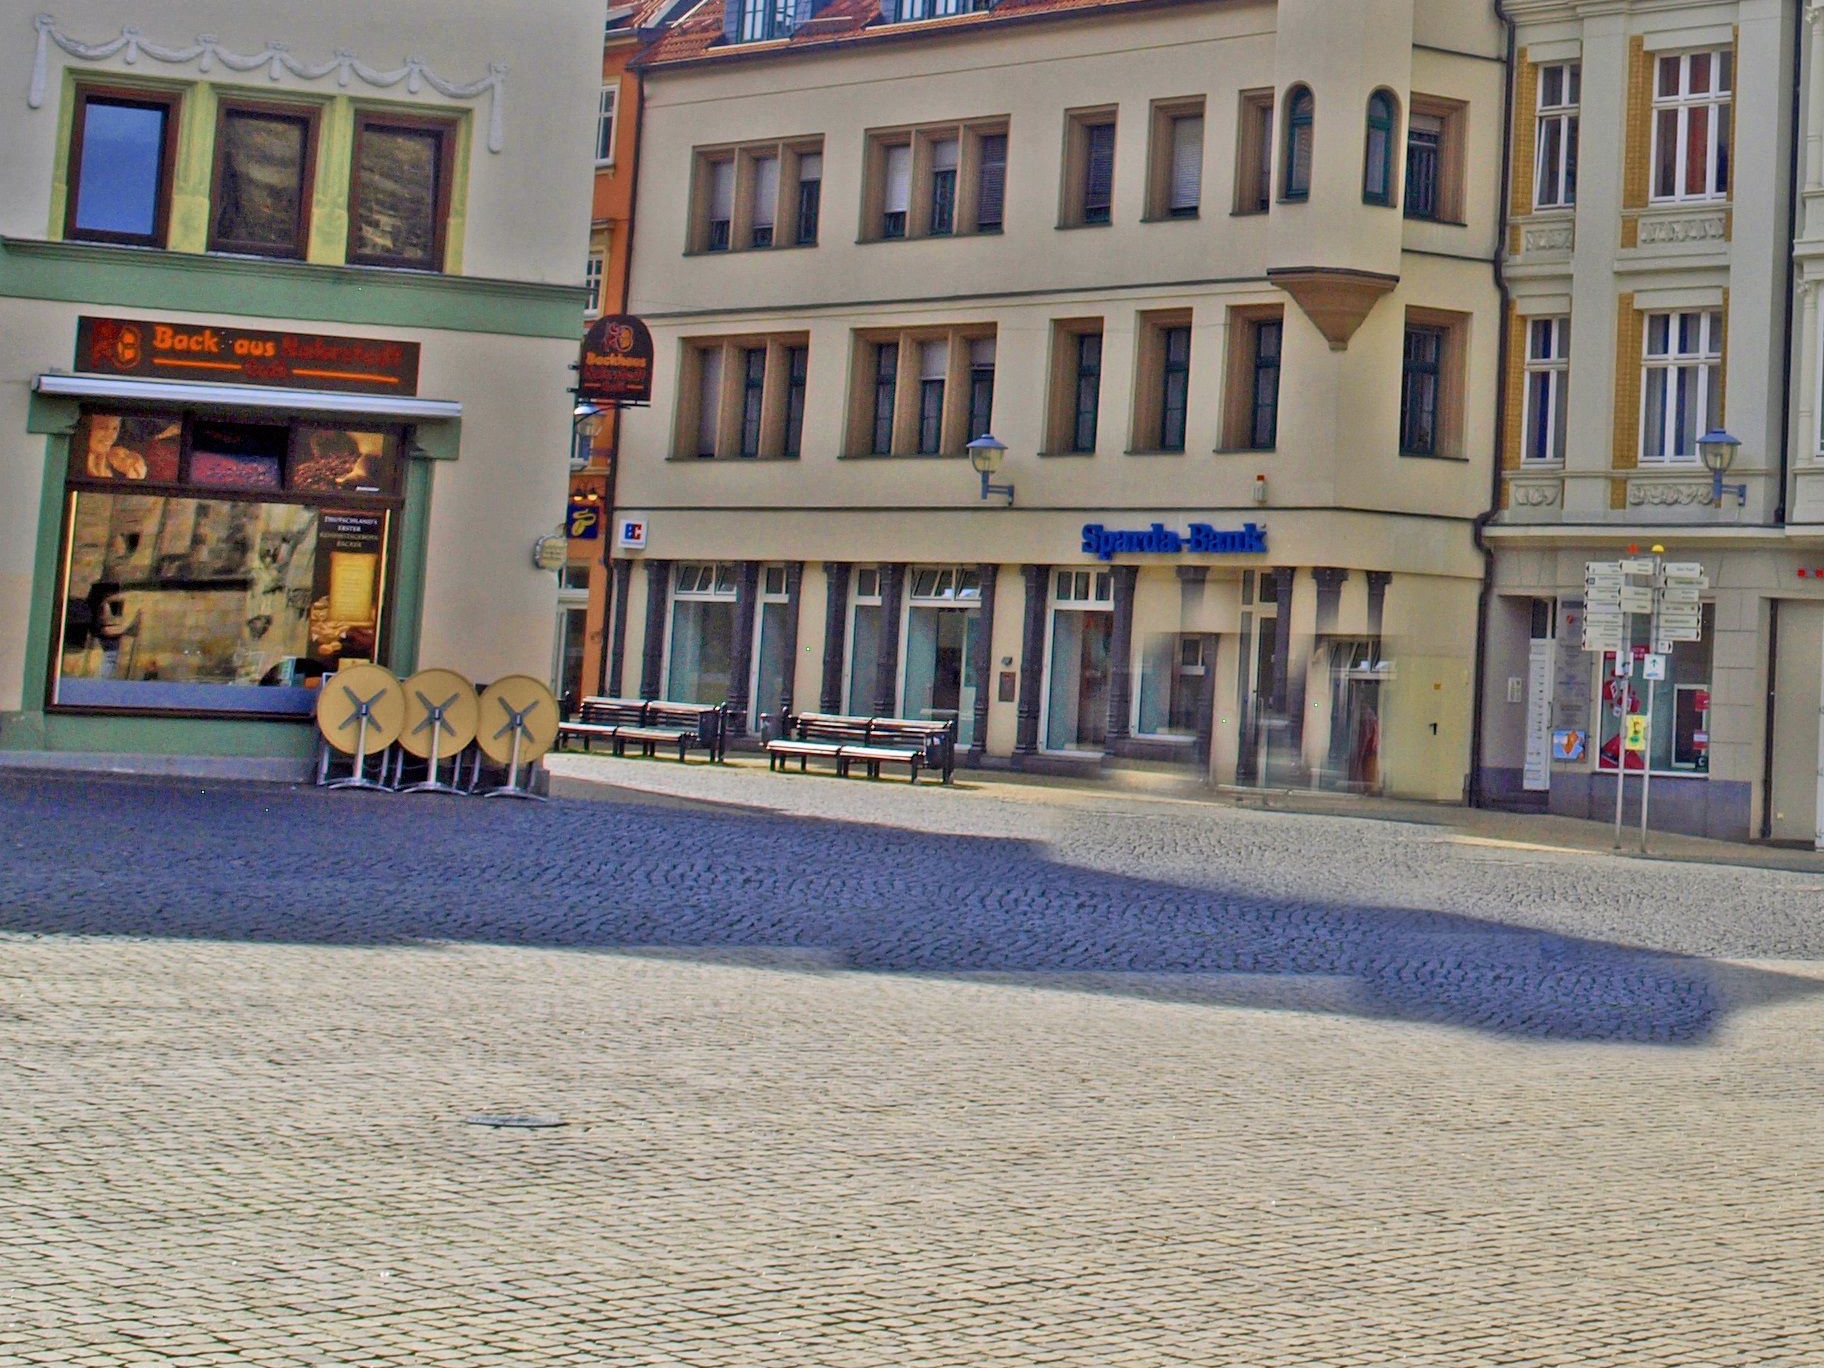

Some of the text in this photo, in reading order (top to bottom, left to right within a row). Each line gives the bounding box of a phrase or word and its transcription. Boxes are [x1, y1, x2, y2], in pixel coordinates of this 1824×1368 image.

[153, 326, 218, 352] Back
[233, 338, 276, 357] aus
[1081, 523, 1268, 561] Sparda-Bank
